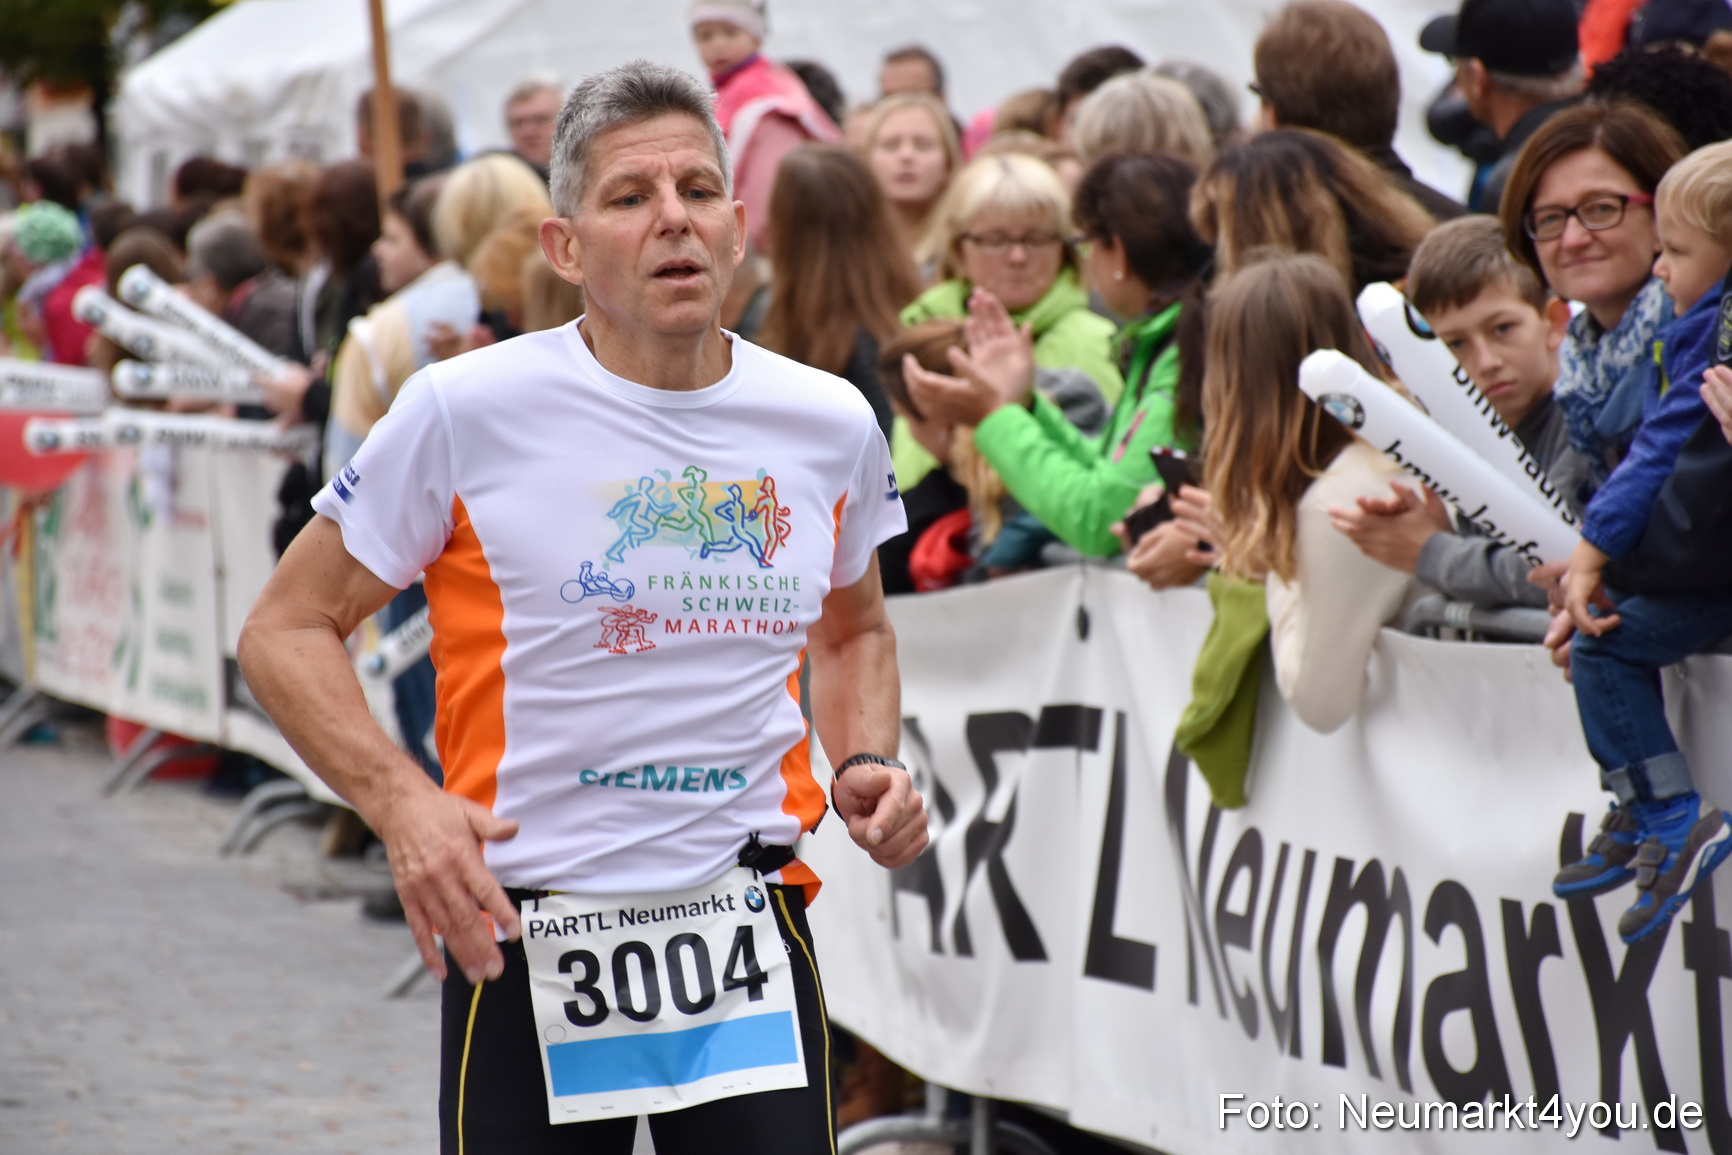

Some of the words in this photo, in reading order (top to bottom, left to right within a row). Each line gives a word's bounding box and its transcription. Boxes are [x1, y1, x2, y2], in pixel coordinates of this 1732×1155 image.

[648, 571, 800, 592] FRÄNKISCHE
[682, 597, 800, 614] SCHWEIZ-
[665, 618, 799, 635] MARATHON
[579, 764, 748, 792] SIEMENS
[528, 911, 612, 939] PARTL
[619, 893, 736, 927] Neumarkt
[886, 704, 1157, 993] ARTL
[1164, 738, 1732, 1155] Neumarkt
[557, 924, 769, 1028] 3004
